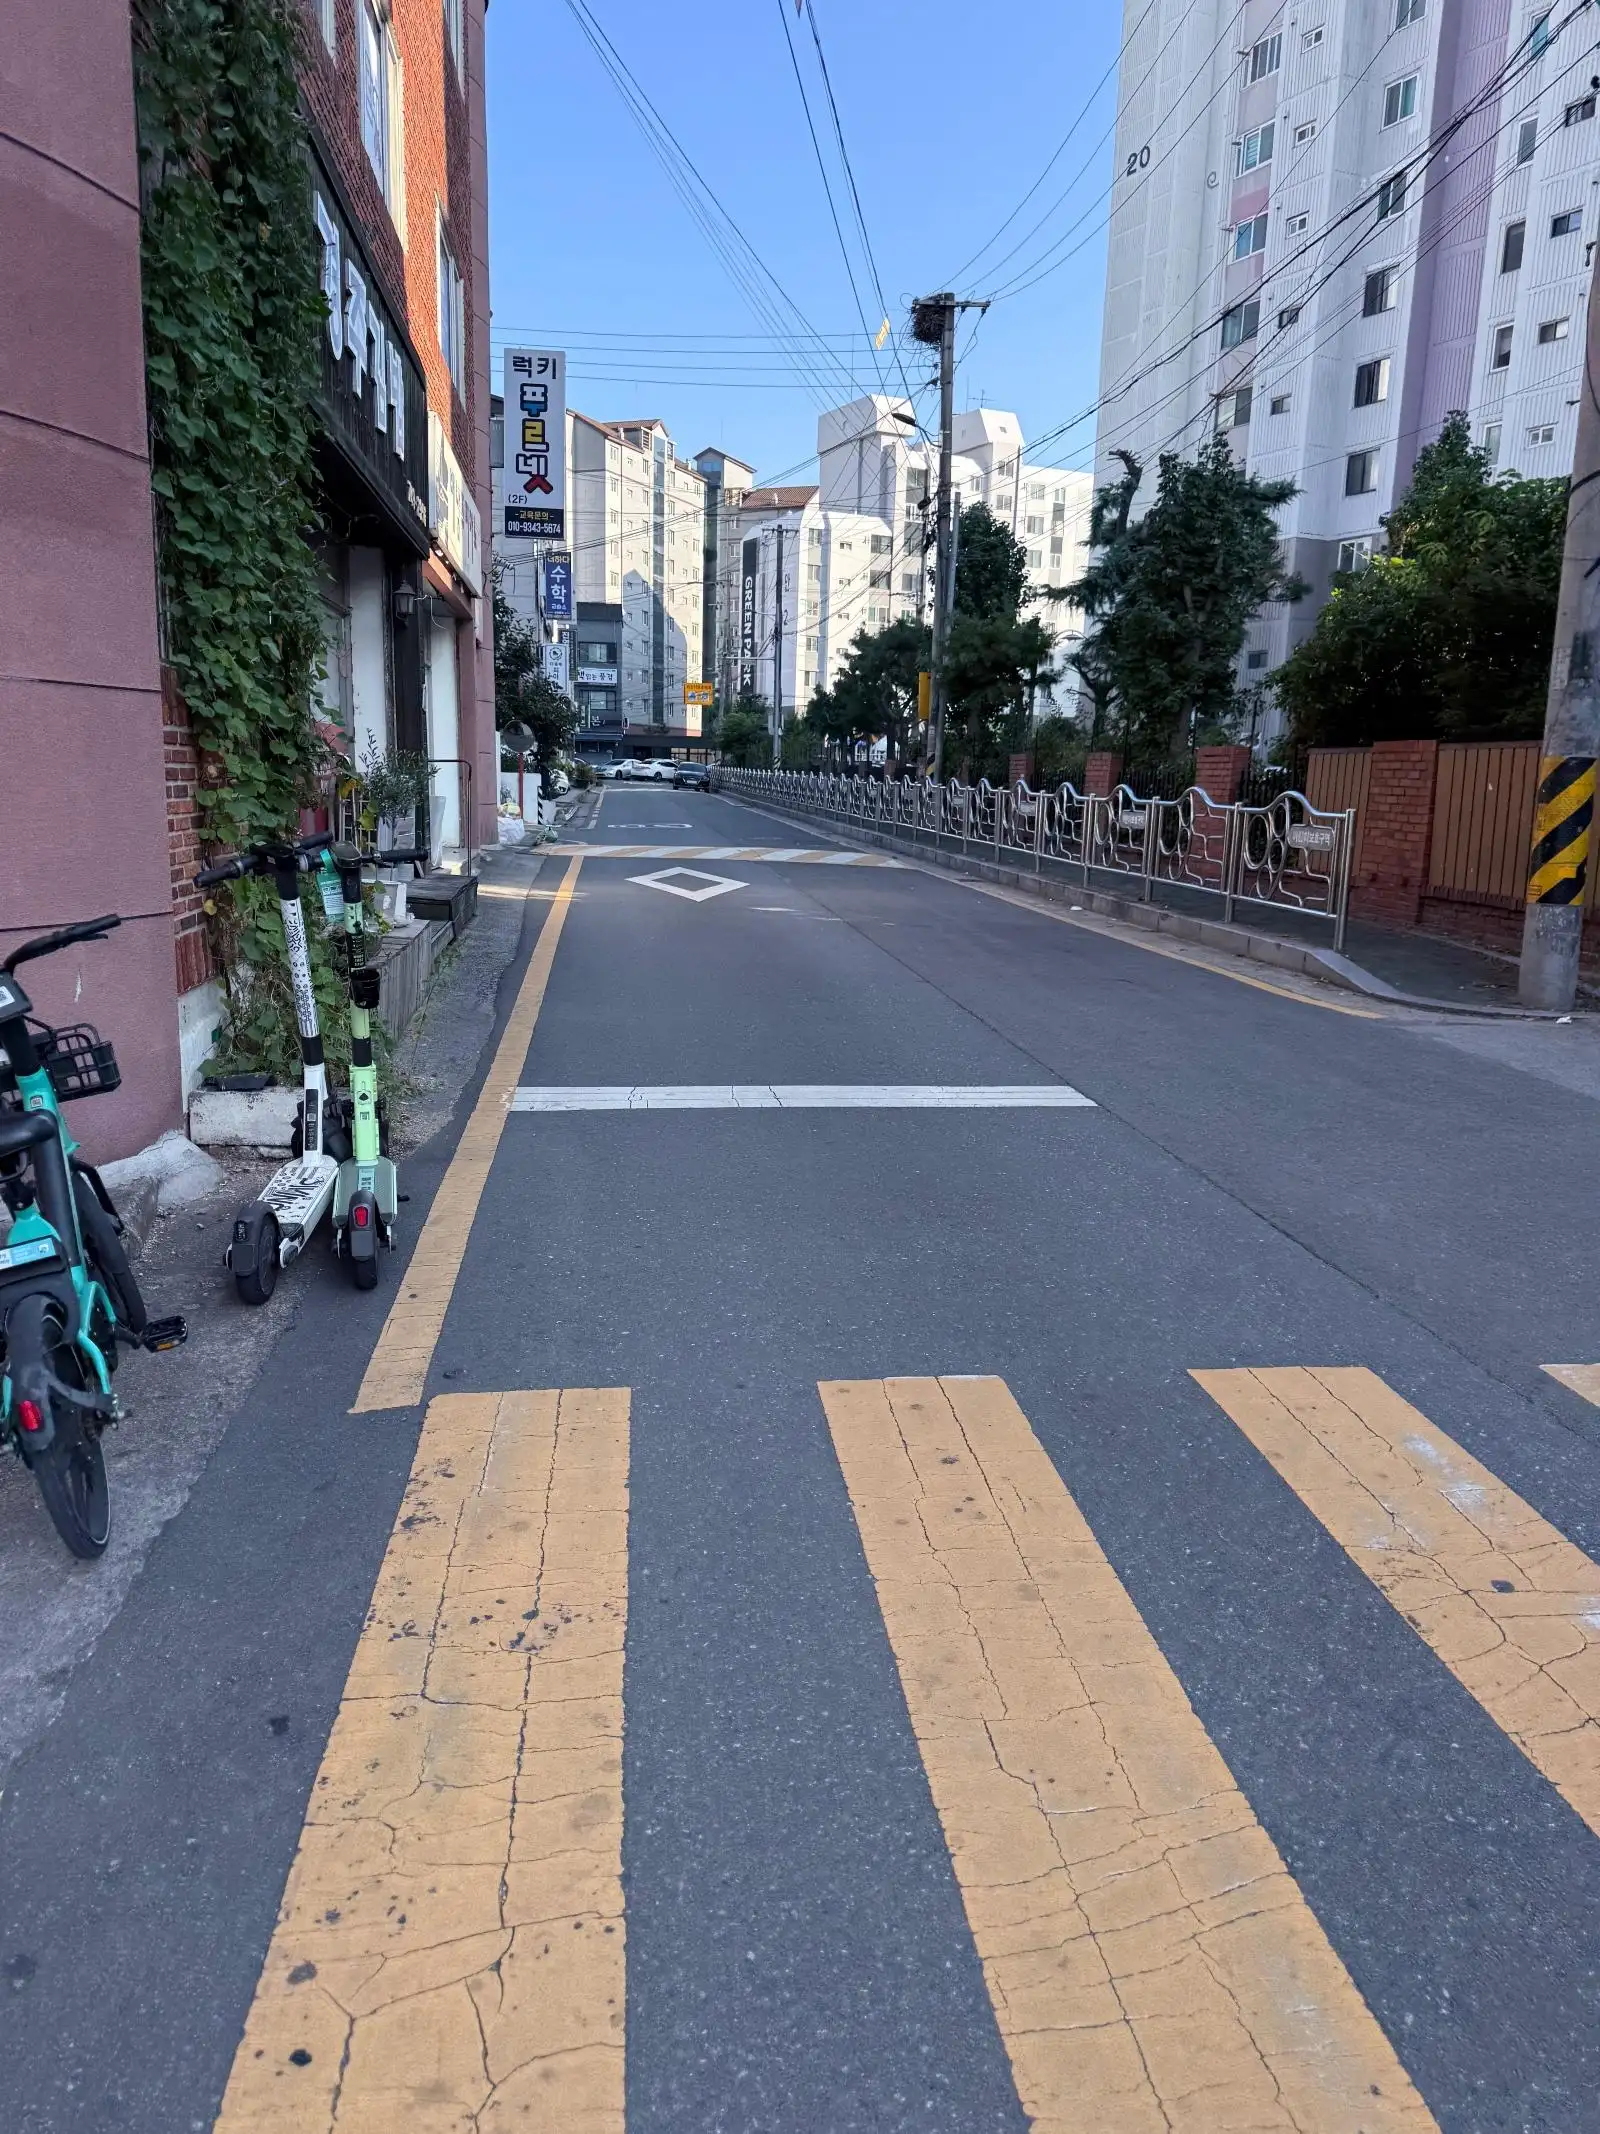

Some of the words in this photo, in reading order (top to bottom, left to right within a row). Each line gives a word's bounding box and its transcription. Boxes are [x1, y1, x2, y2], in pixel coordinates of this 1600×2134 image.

[1126, 145, 1151, 177] 20
[512, 356, 557, 379] 럭키
[515, 383, 554, 494] 푸르넷
[508, 494, 528, 504] (2F)
[550, 565, 567, 604] 수학
[744, 575, 754, 635] GREEN
[743, 638, 753, 686] PARK
